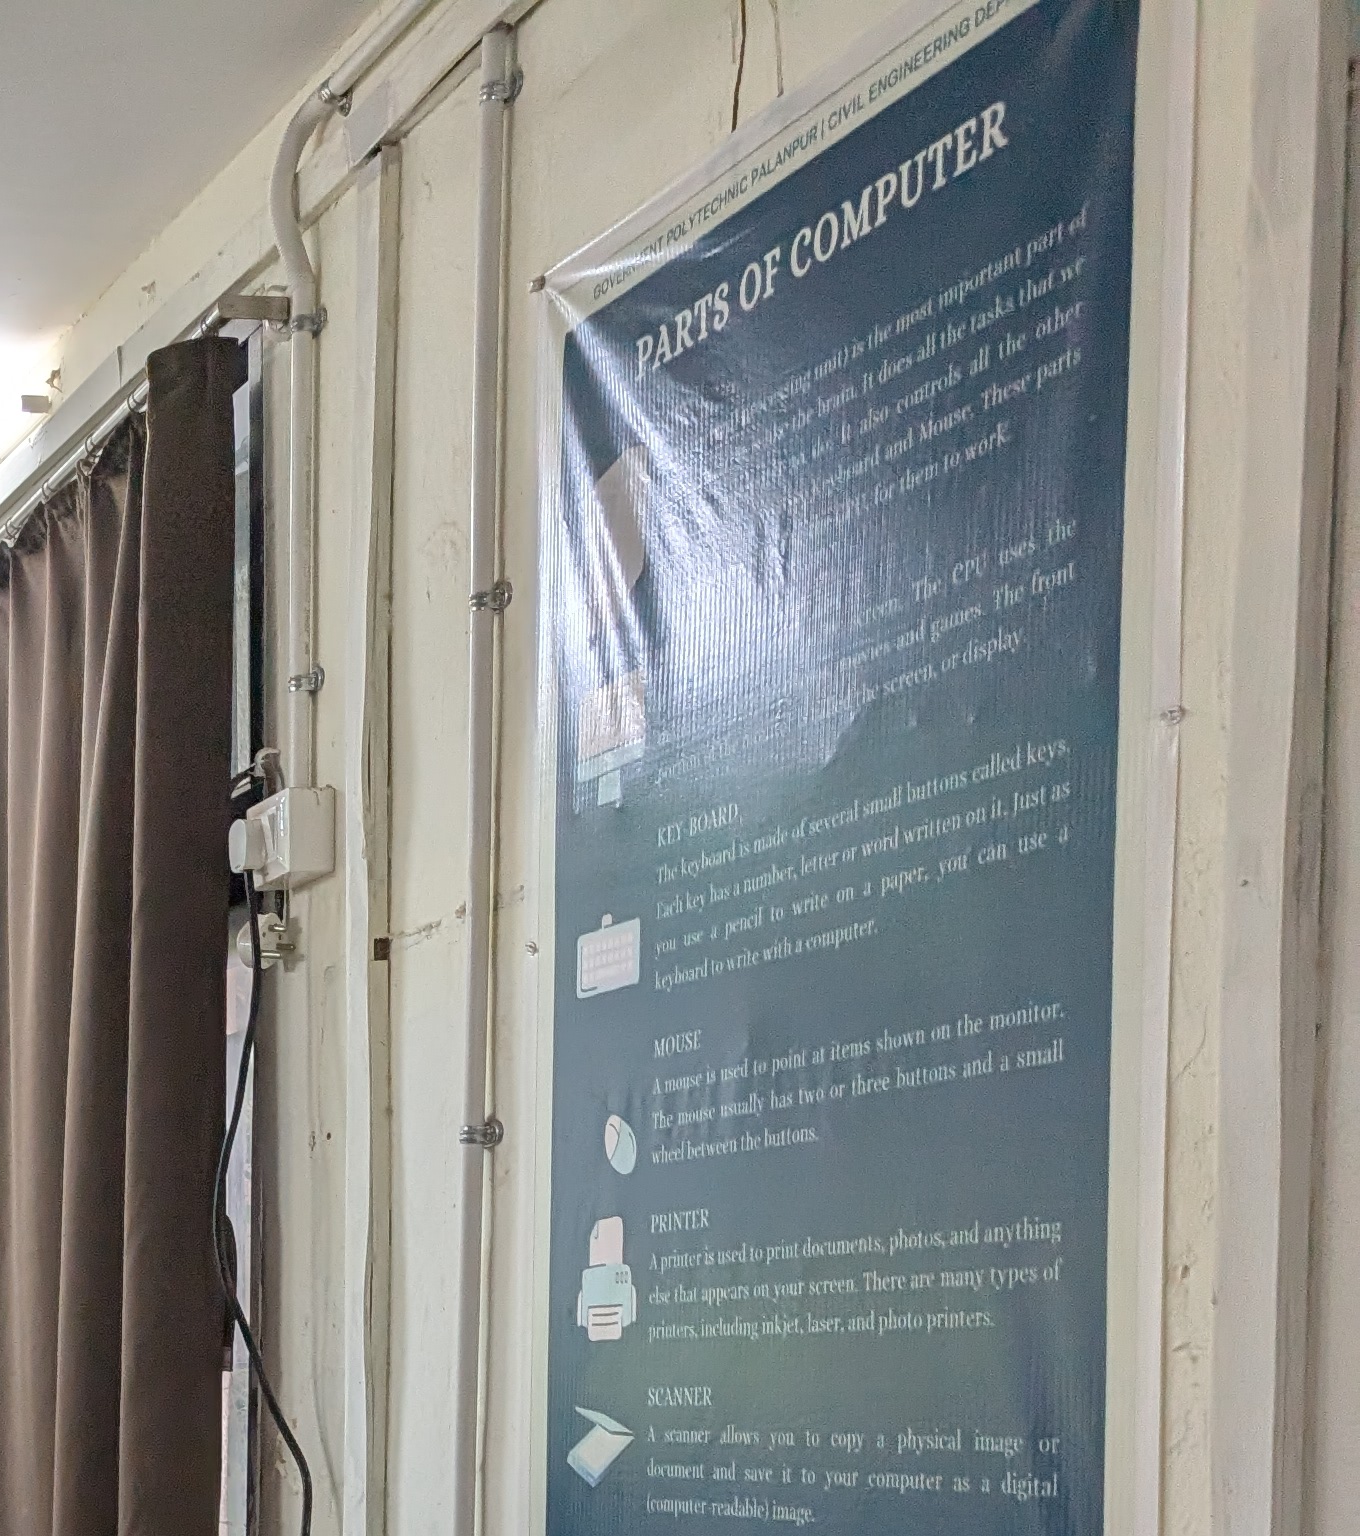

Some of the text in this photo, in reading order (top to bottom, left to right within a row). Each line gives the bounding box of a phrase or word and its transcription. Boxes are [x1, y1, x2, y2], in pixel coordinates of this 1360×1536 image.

[666, 177, 749, 247] POLYTECHNIC
[750, 125, 819, 188] PALANPUR
[828, 96, 865, 132] CIVIL
[868, 16, 972, 104] ENGINEERING
[635, 100, 1009, 381] PARTS OF COMPUTER
[654, 1028, 702, 1059] MOUSE
[650, 1208, 709, 1233] PRINTER
[649, 1252, 658, 1271] A
[659, 1249, 702, 1275] printer
[704, 1245, 715, 1266] is
[717, 1242, 746, 1265] used
[749, 1244, 763, 1262] to
[765, 1239, 800, 1265] print
[802, 1235, 885, 1259] documents,
[949, 1219, 979, 1246] and
[984, 1215, 1062, 1249] anything
[700, 1315, 759, 1341] including
[847, 1309, 876, 1331] and
[879, 1306, 922, 1337] photo
[647, 1386, 712, 1407] SCANNER
[664, 1429, 711, 1445] scanner
[719, 1423, 760, 1446] allows
[768, 1431, 796, 1451] you
[806, 1430, 820, 1448] to
[830, 1430, 864, 1453] copy
[876, 1434, 885, 1449] a
[897, 1426, 961, 1455] physical
[974, 1428, 1023, 1457] image
[1038, 1437, 1061, 1455] or
